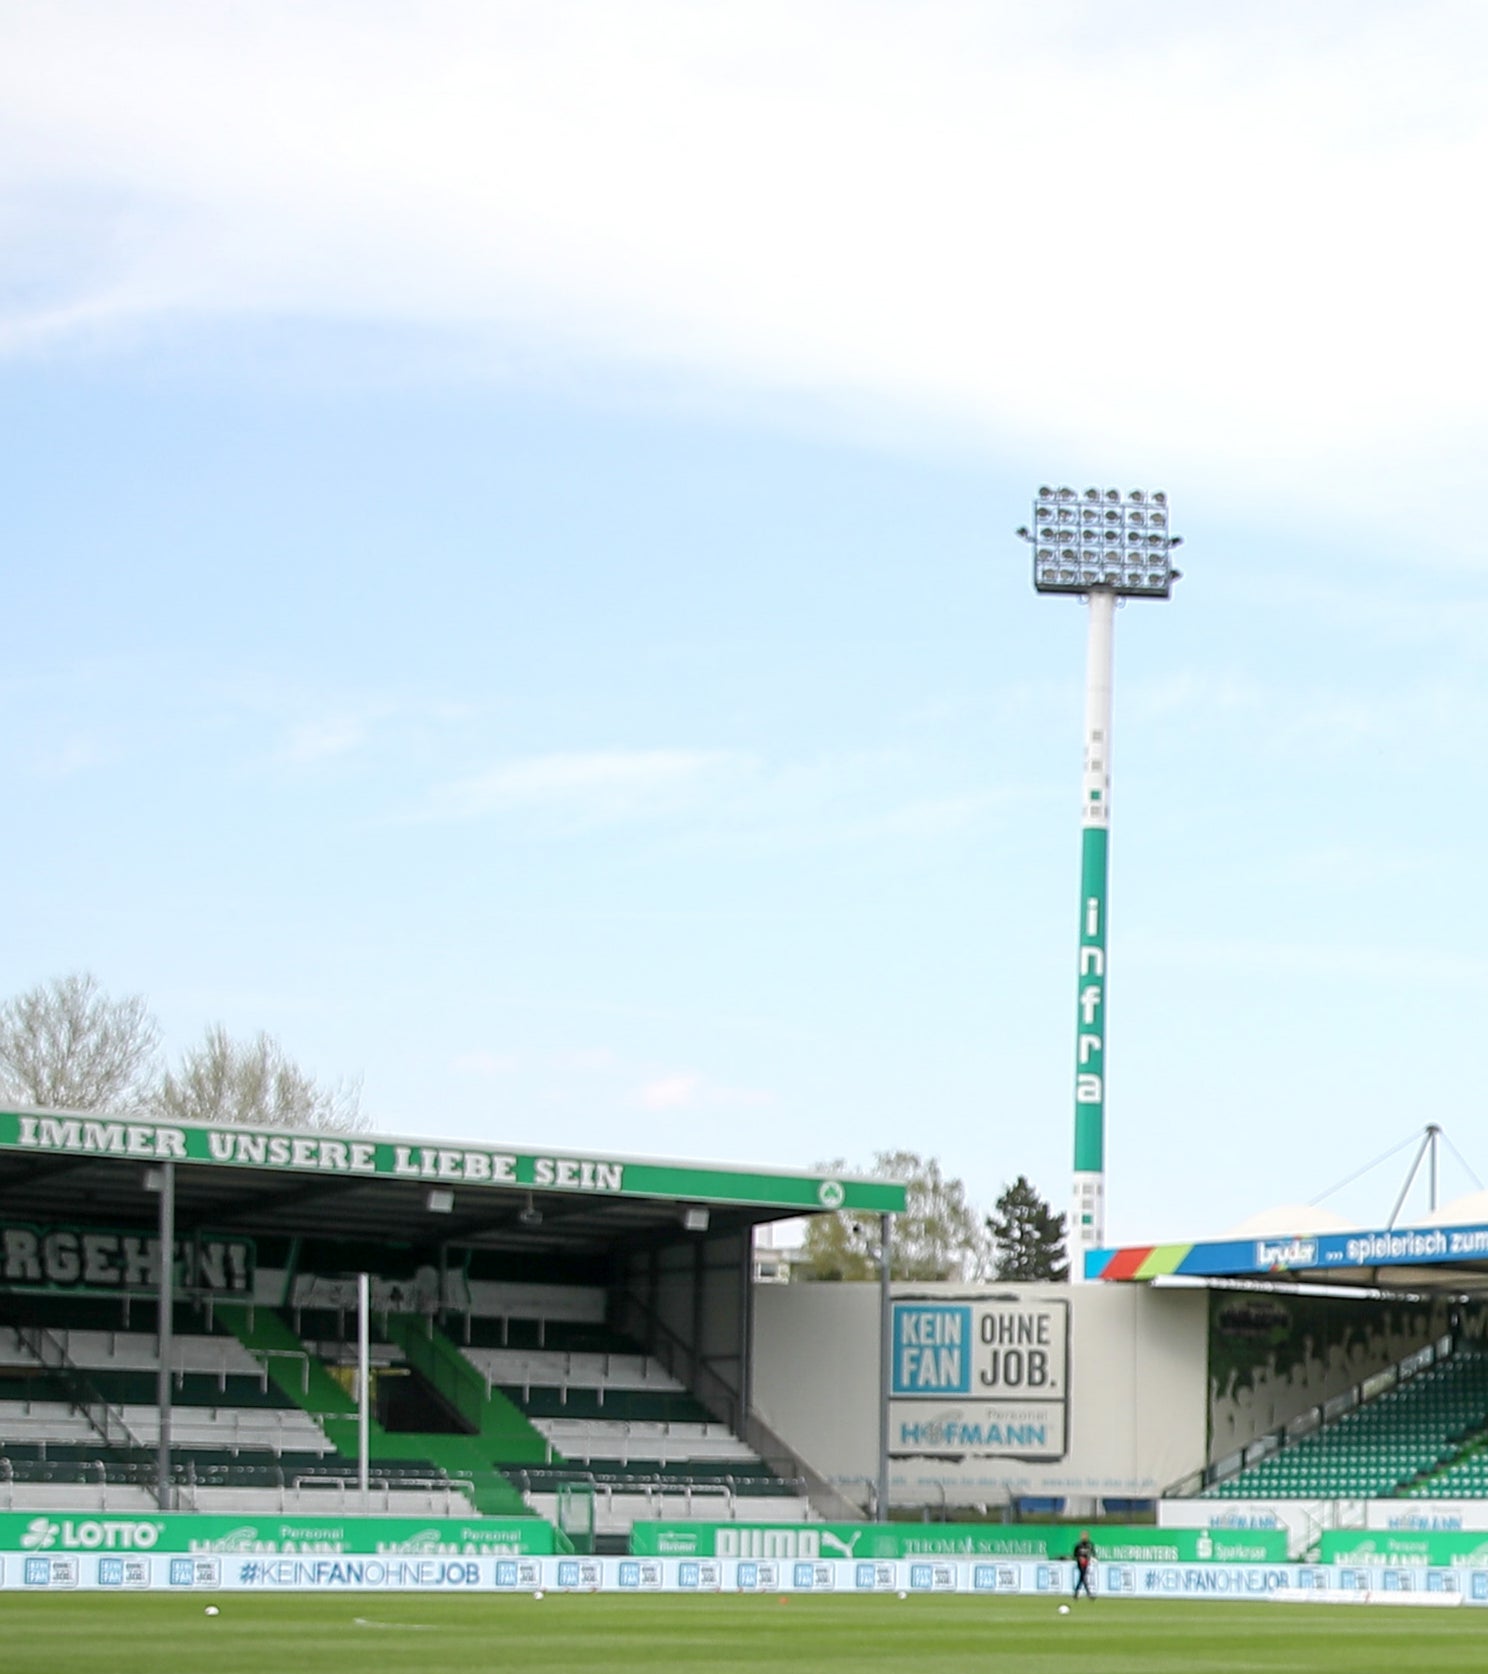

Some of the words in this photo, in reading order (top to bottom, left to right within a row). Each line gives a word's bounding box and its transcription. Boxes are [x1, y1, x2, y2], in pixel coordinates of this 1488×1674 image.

[1077, 897, 1104, 1103] infra
[18, 1116, 187, 1158] IMMER
[207, 1131, 376, 1174] UNSERE
[394, 1145, 517, 1183] LIEBE
[534, 1158, 624, 1190] SEIN
[1259, 1241, 1315, 1265] bruder
[1347, 1230, 1447, 1264] spielerisch
[902, 1313, 962, 1345] KEIN
[981, 1314, 1051, 1345] OHNE
[902, 1348, 961, 1387] FAN
[980, 1350, 1057, 1387] JOB.
[901, 1422, 1046, 1446] HOFMANN
[62, 1521, 159, 1548] LOTTO
[240, 1560, 481, 1585] #KEINFANOHNEJOB
